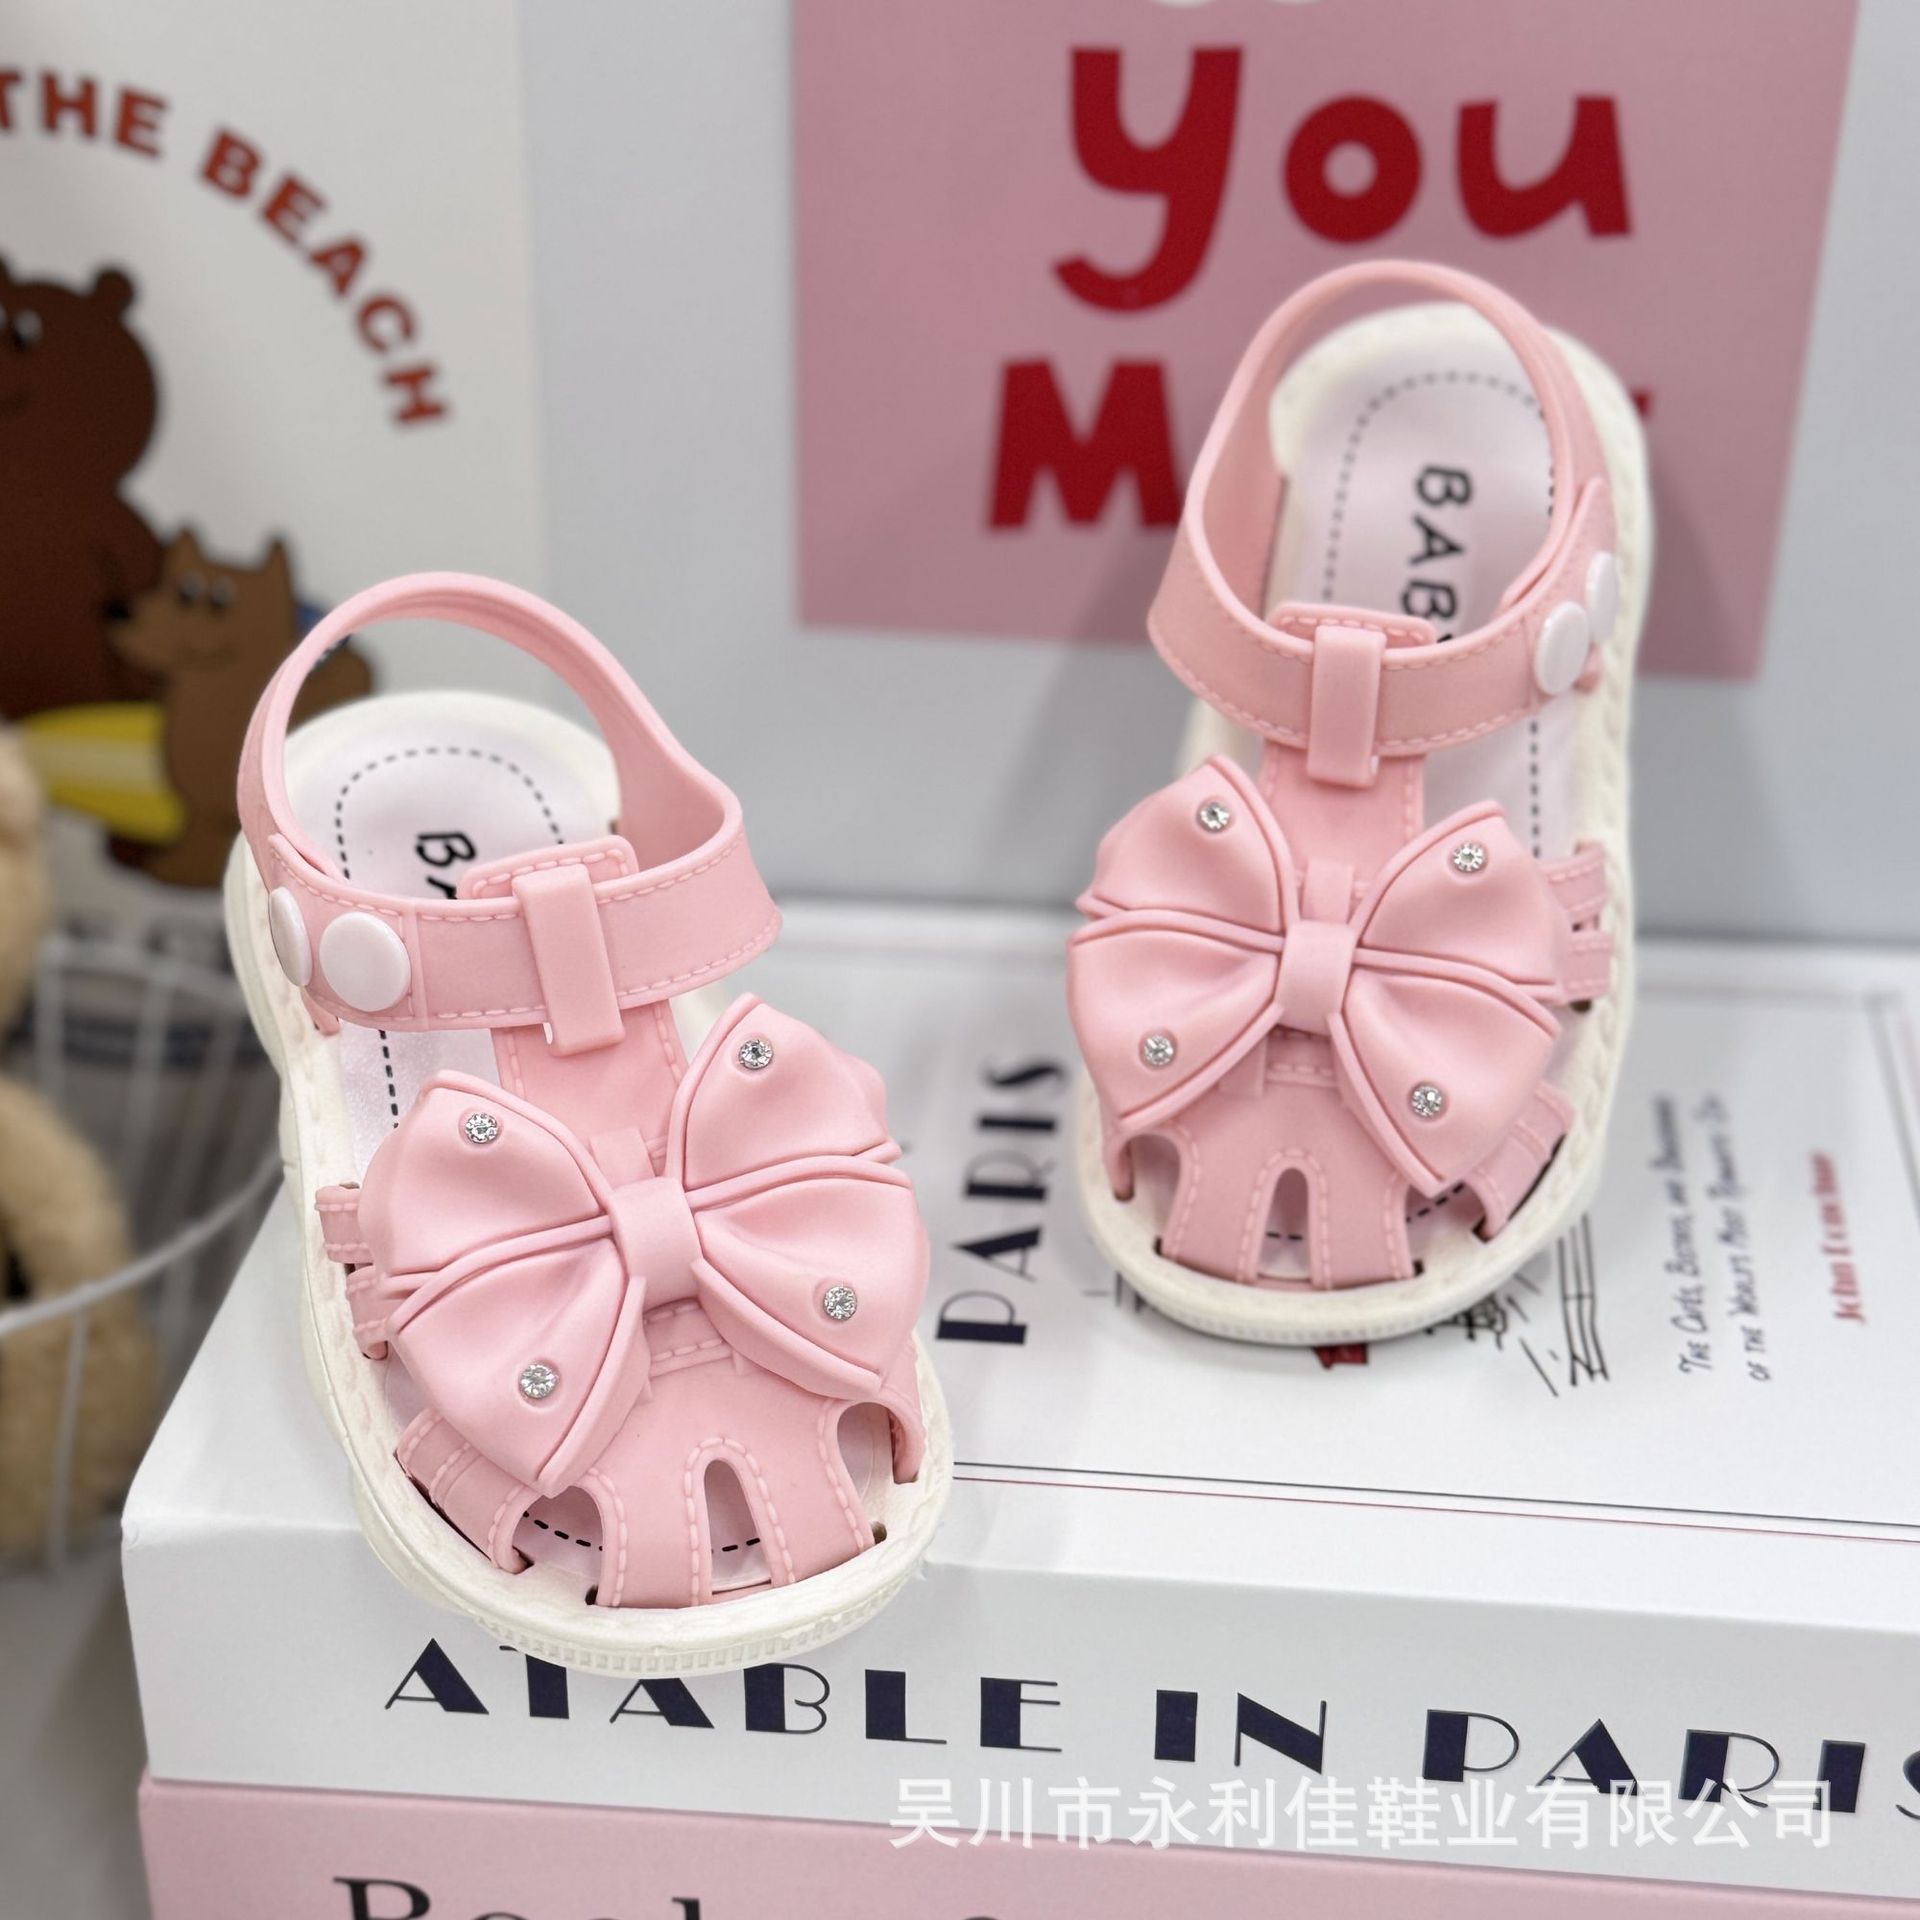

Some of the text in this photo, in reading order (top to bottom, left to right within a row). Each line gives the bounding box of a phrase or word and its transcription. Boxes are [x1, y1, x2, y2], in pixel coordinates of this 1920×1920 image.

[200, 128, 450, 430] BEACH
[1401, 467, 1473, 643] BAB
[935, 1056, 1071, 1346] PARIS
[1154, 1689, 1327, 1774] IN
